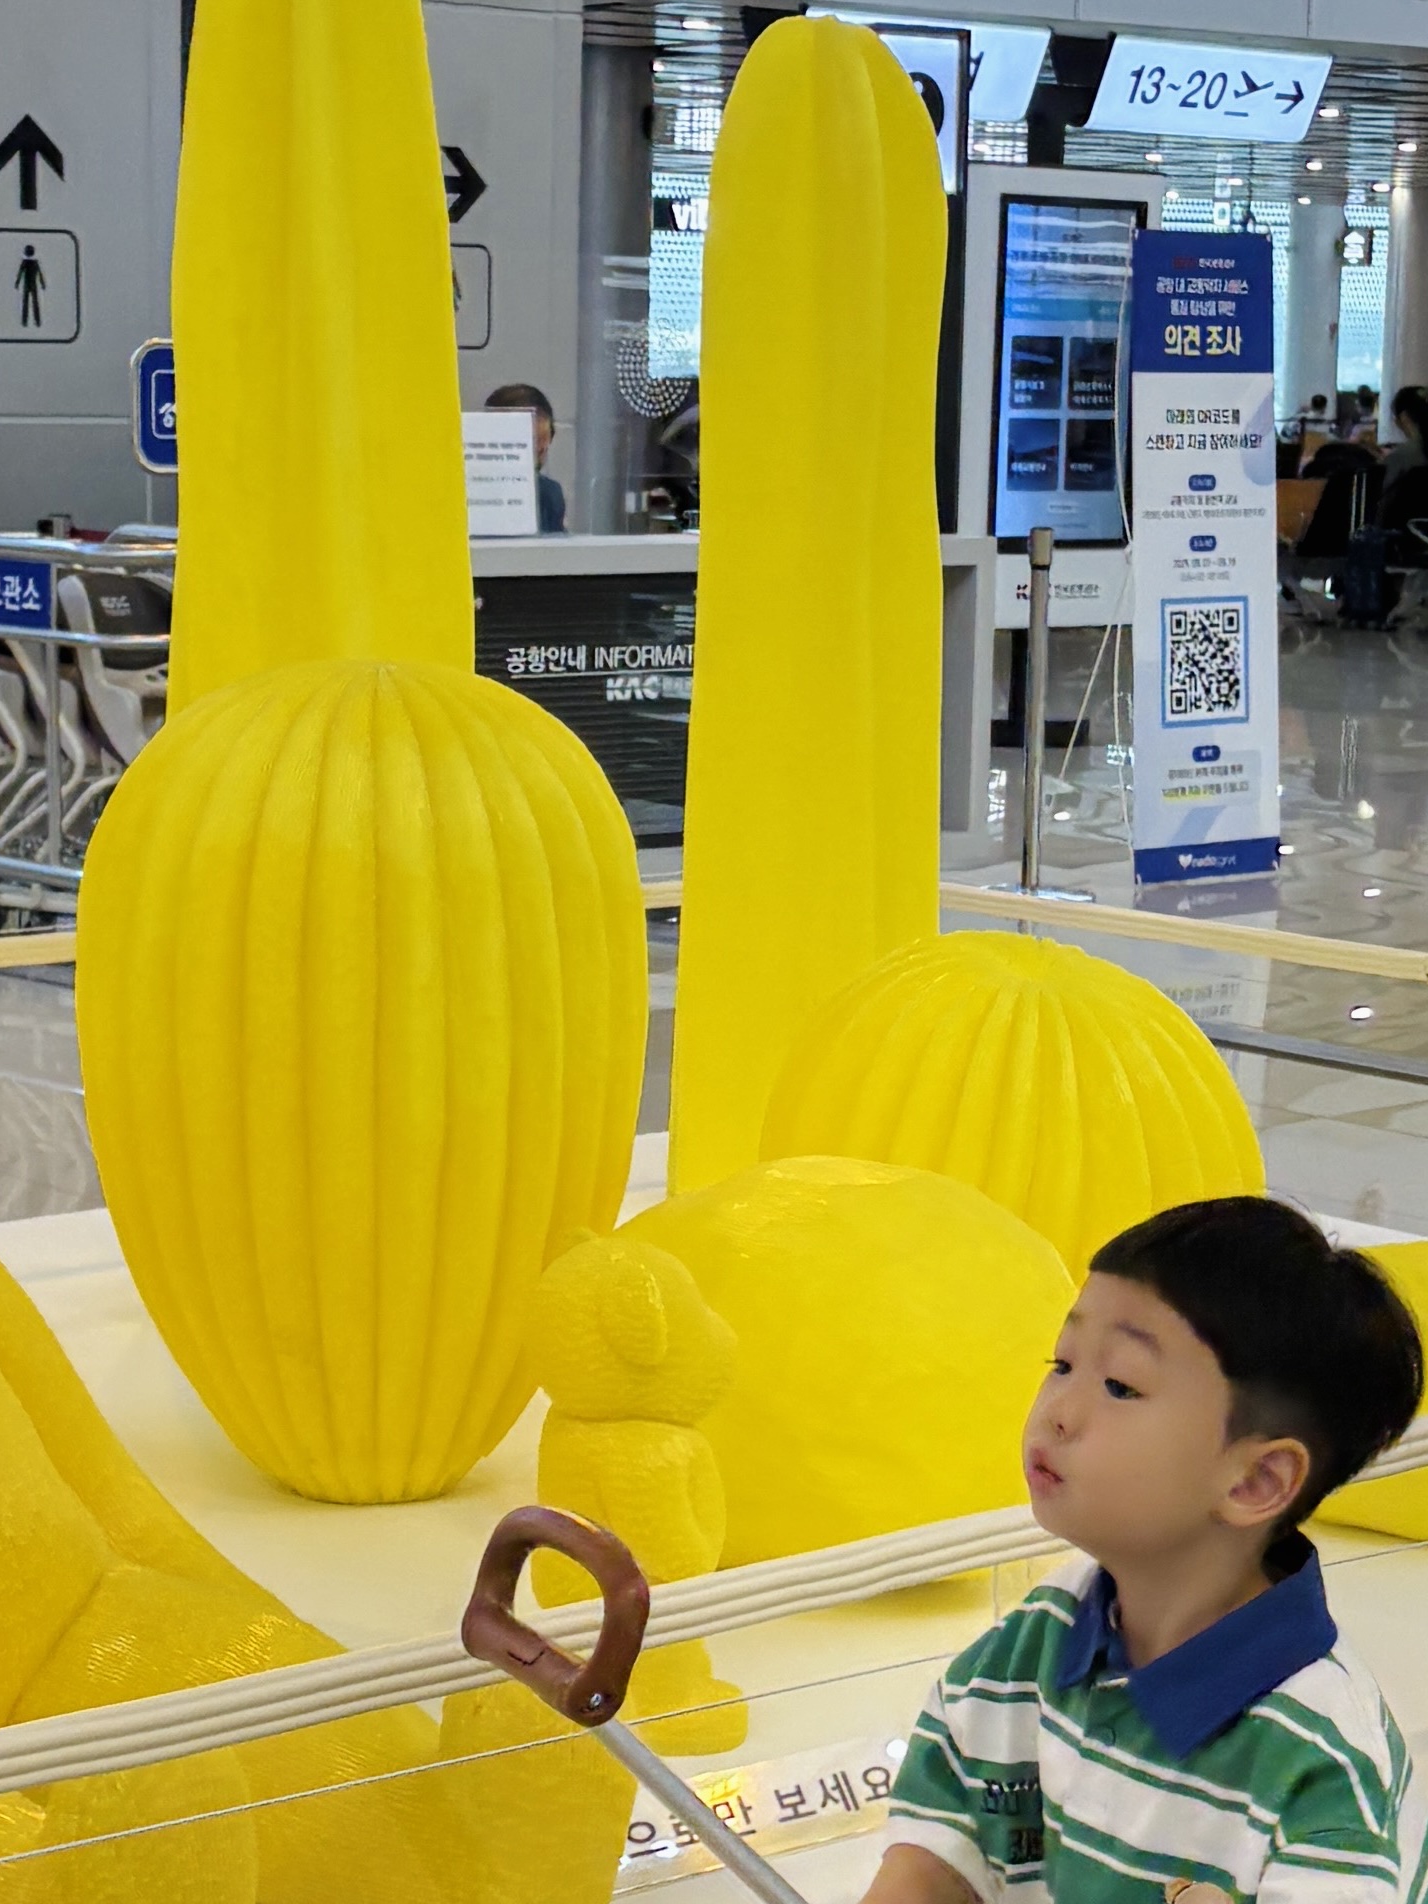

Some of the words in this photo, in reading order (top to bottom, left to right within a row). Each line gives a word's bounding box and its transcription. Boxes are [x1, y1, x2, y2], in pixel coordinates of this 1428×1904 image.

[1128, 64, 1227, 110] 13~20
[1164, 324, 1201, 356] 의견
[1206, 325, 1242, 356] 조사
[506, 645, 586, 673] 공항안내
[606, 674, 662, 702] KAC
[774, 1765, 893, 1823] 보세요
